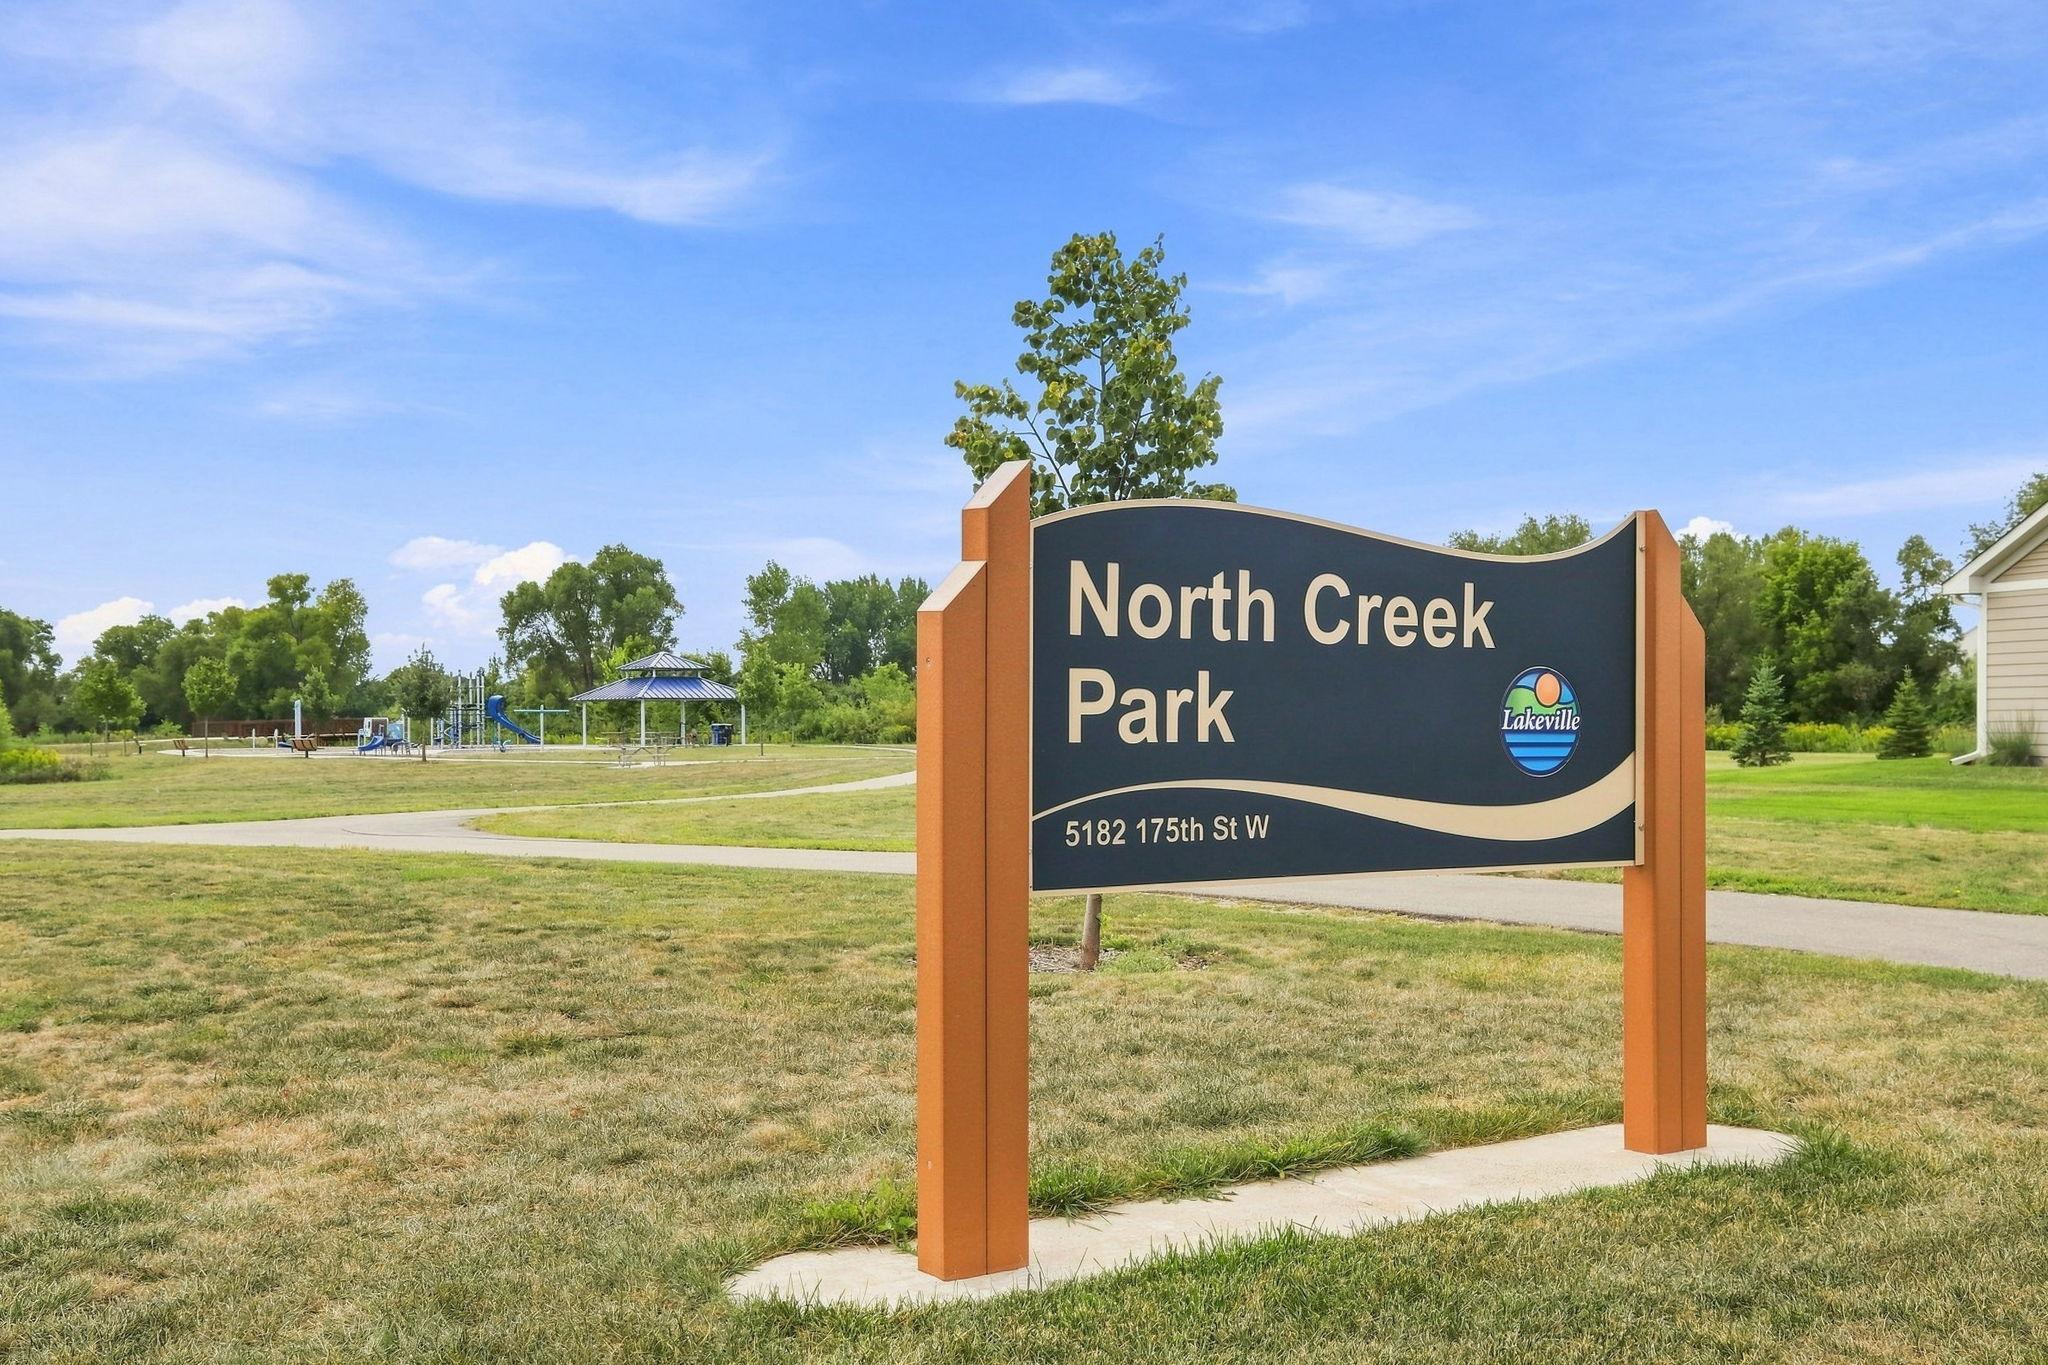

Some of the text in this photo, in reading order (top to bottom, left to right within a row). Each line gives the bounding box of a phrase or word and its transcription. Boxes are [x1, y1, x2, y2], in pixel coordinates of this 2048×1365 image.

[1070, 560, 1495, 648] North Creek
[1069, 668, 1235, 744] Park
[1502, 708, 1579, 730] Lakeville
[1066, 815, 1269, 846] 5182 175th St W
